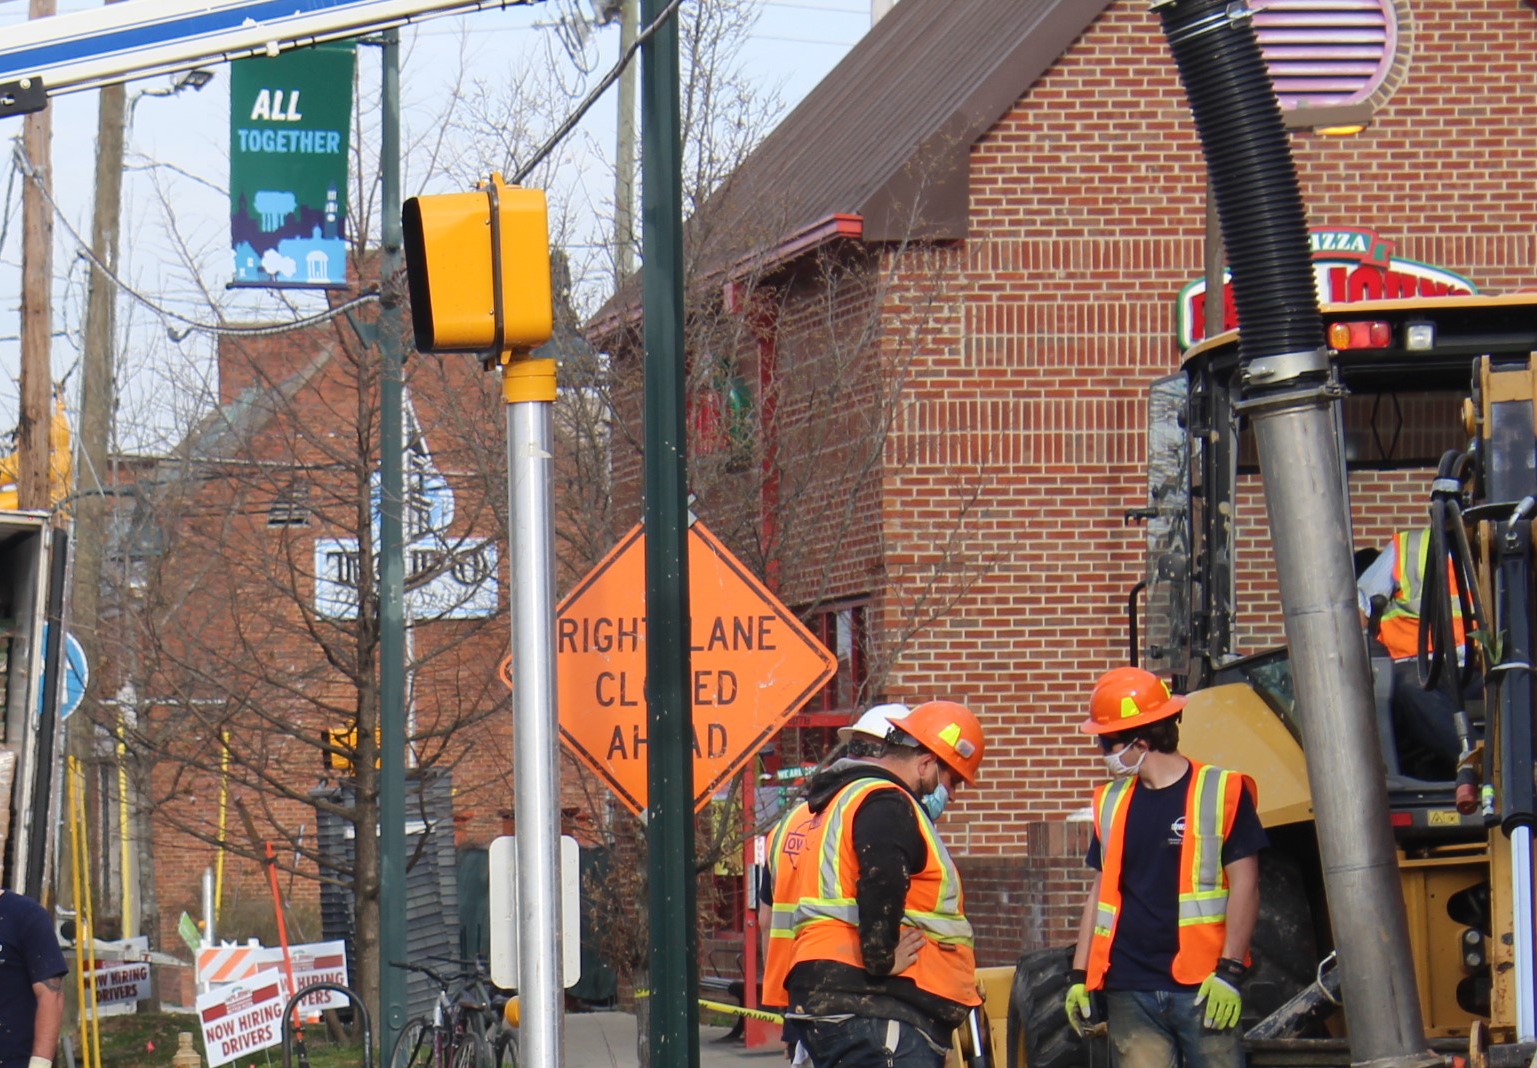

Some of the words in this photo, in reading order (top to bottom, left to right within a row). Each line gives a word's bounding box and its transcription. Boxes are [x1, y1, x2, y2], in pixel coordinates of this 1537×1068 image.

[250, 88, 303, 121] ALL
[237, 128, 341, 154] TOGETHER
[1309, 233, 1367, 252] IZZA
[558, 617, 648, 653] RIGH
[595, 670, 738, 707] CLED
[606, 722, 728, 760] AHAD
[111, 967, 148, 985] HIRING
[95, 984, 138, 1003] DRIVERS
[206, 1018, 234, 1044] NOW
[238, 1002, 282, 1031] HIRING
[221, 1025, 273, 1058] DRIVERS
